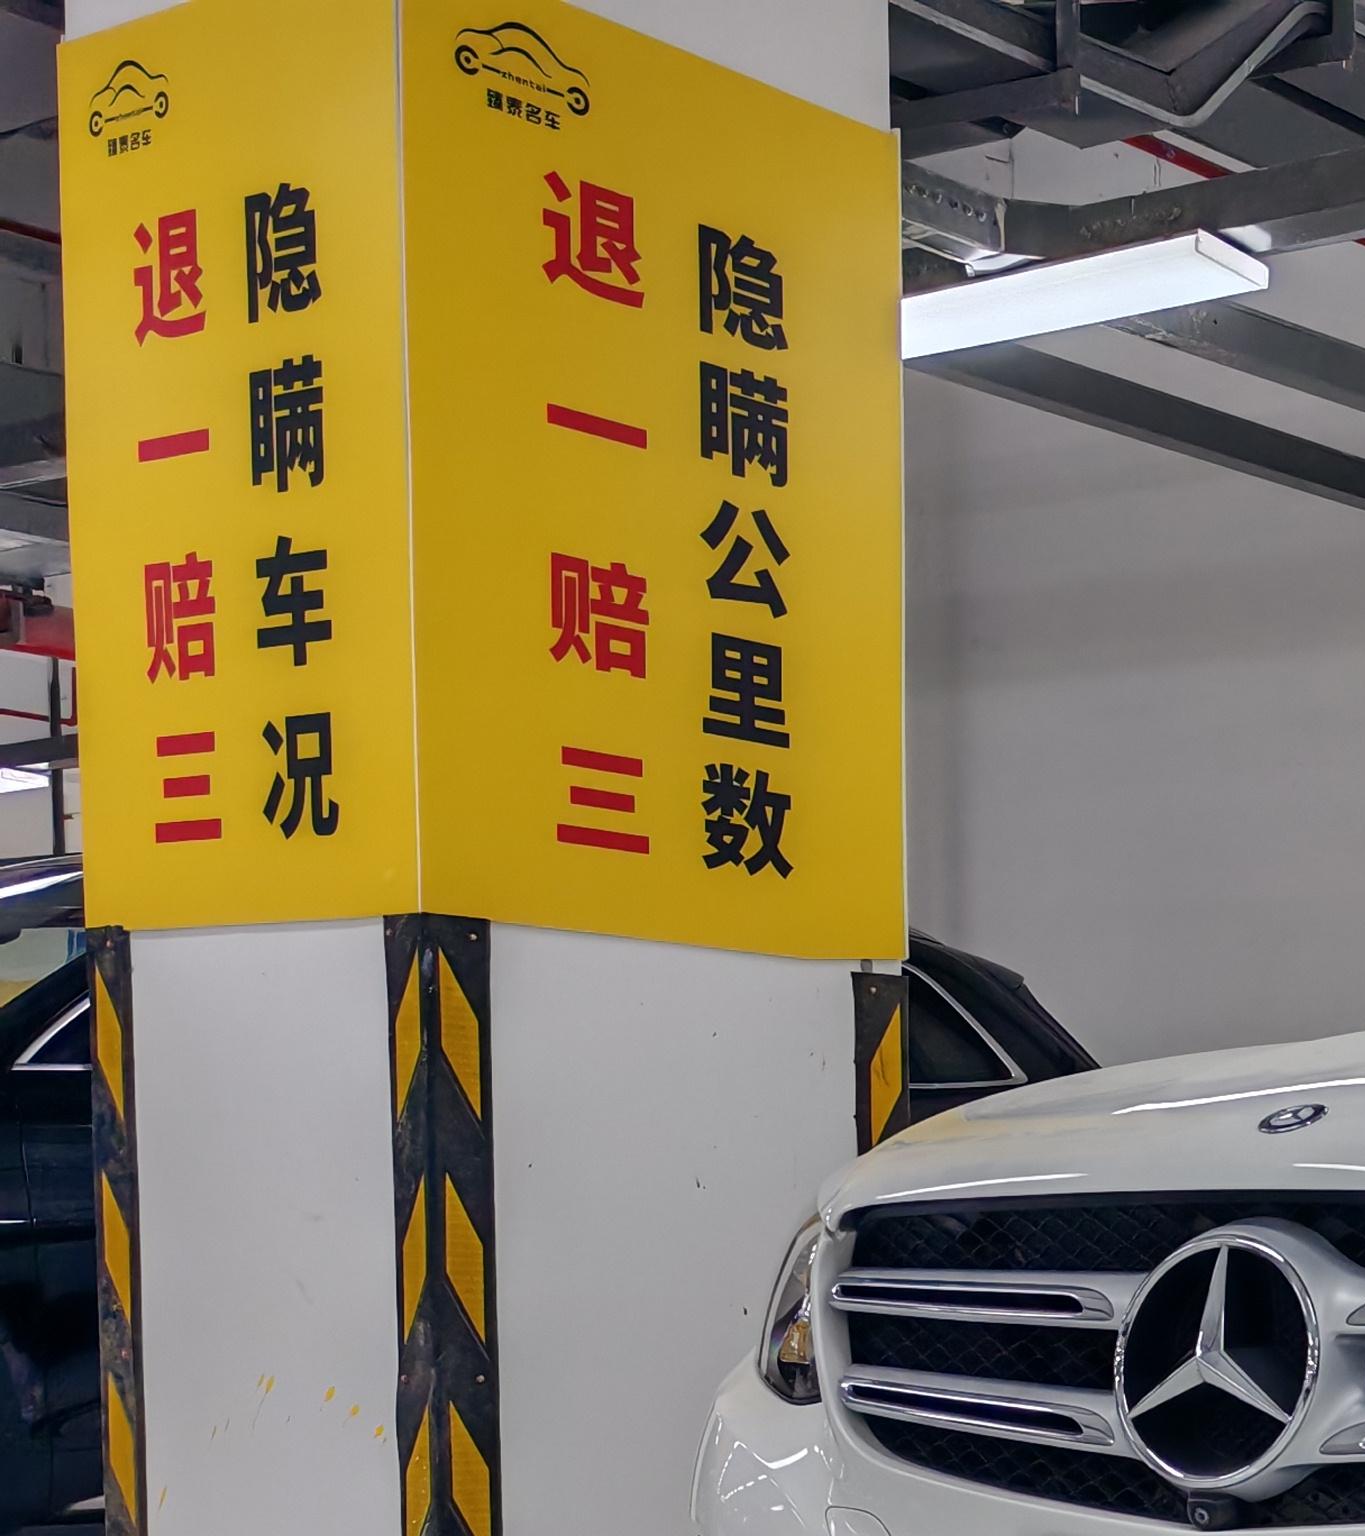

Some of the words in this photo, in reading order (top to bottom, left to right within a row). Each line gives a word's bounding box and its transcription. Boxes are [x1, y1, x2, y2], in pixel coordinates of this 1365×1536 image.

[132, 208, 223, 844] 退一赔三
[243, 182, 340, 840] 隐瞒车况
[541, 170, 650, 855] 退一赔三
[697, 223, 794, 879] 隐瞒公里数
